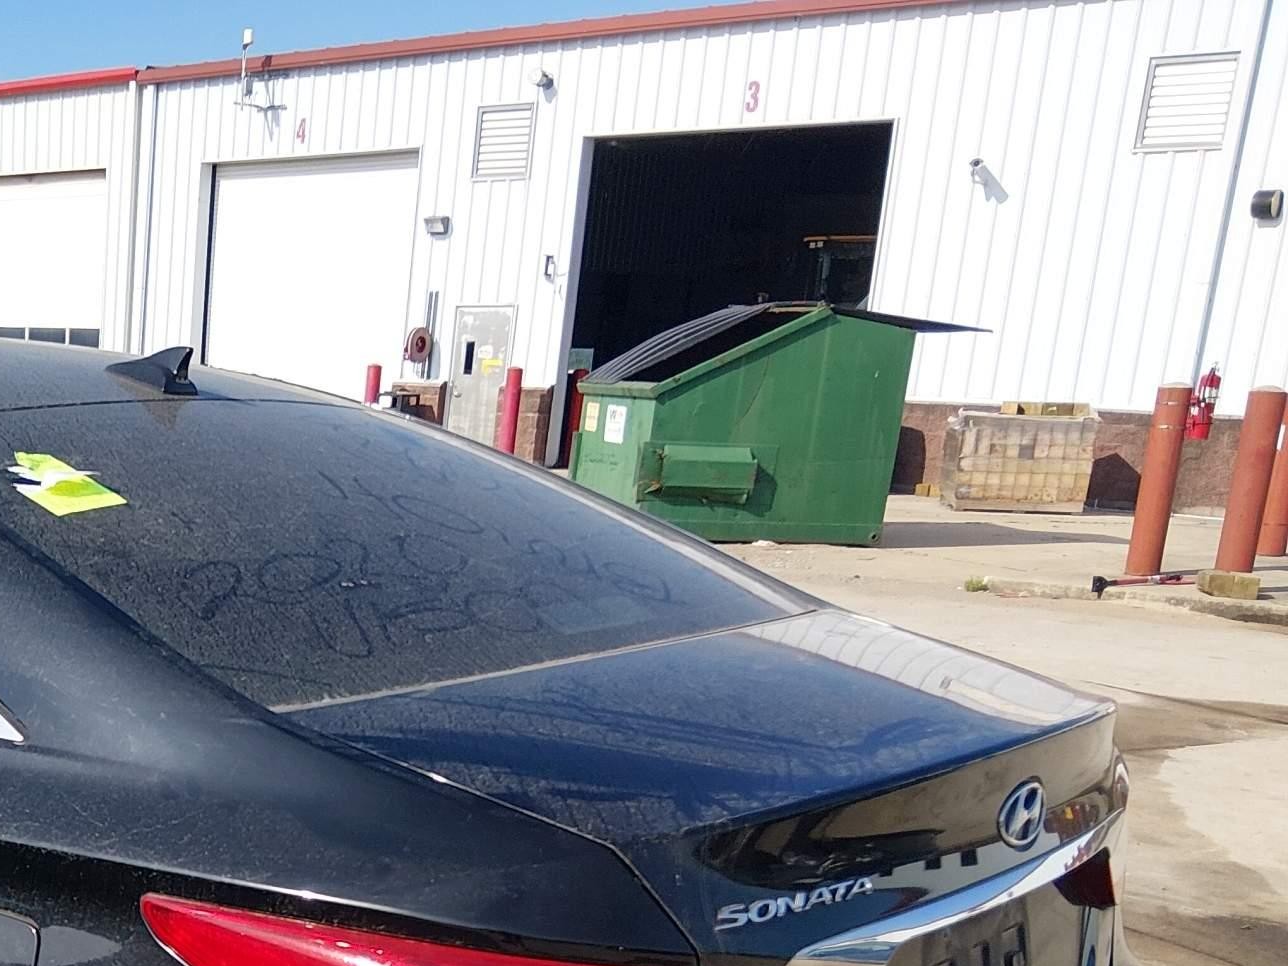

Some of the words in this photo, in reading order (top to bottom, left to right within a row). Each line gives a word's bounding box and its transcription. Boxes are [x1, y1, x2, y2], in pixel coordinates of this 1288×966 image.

[745, 80, 760, 112] 3
[296, 118, 306, 144] 4
[714, 876, 876, 931] SONATA
